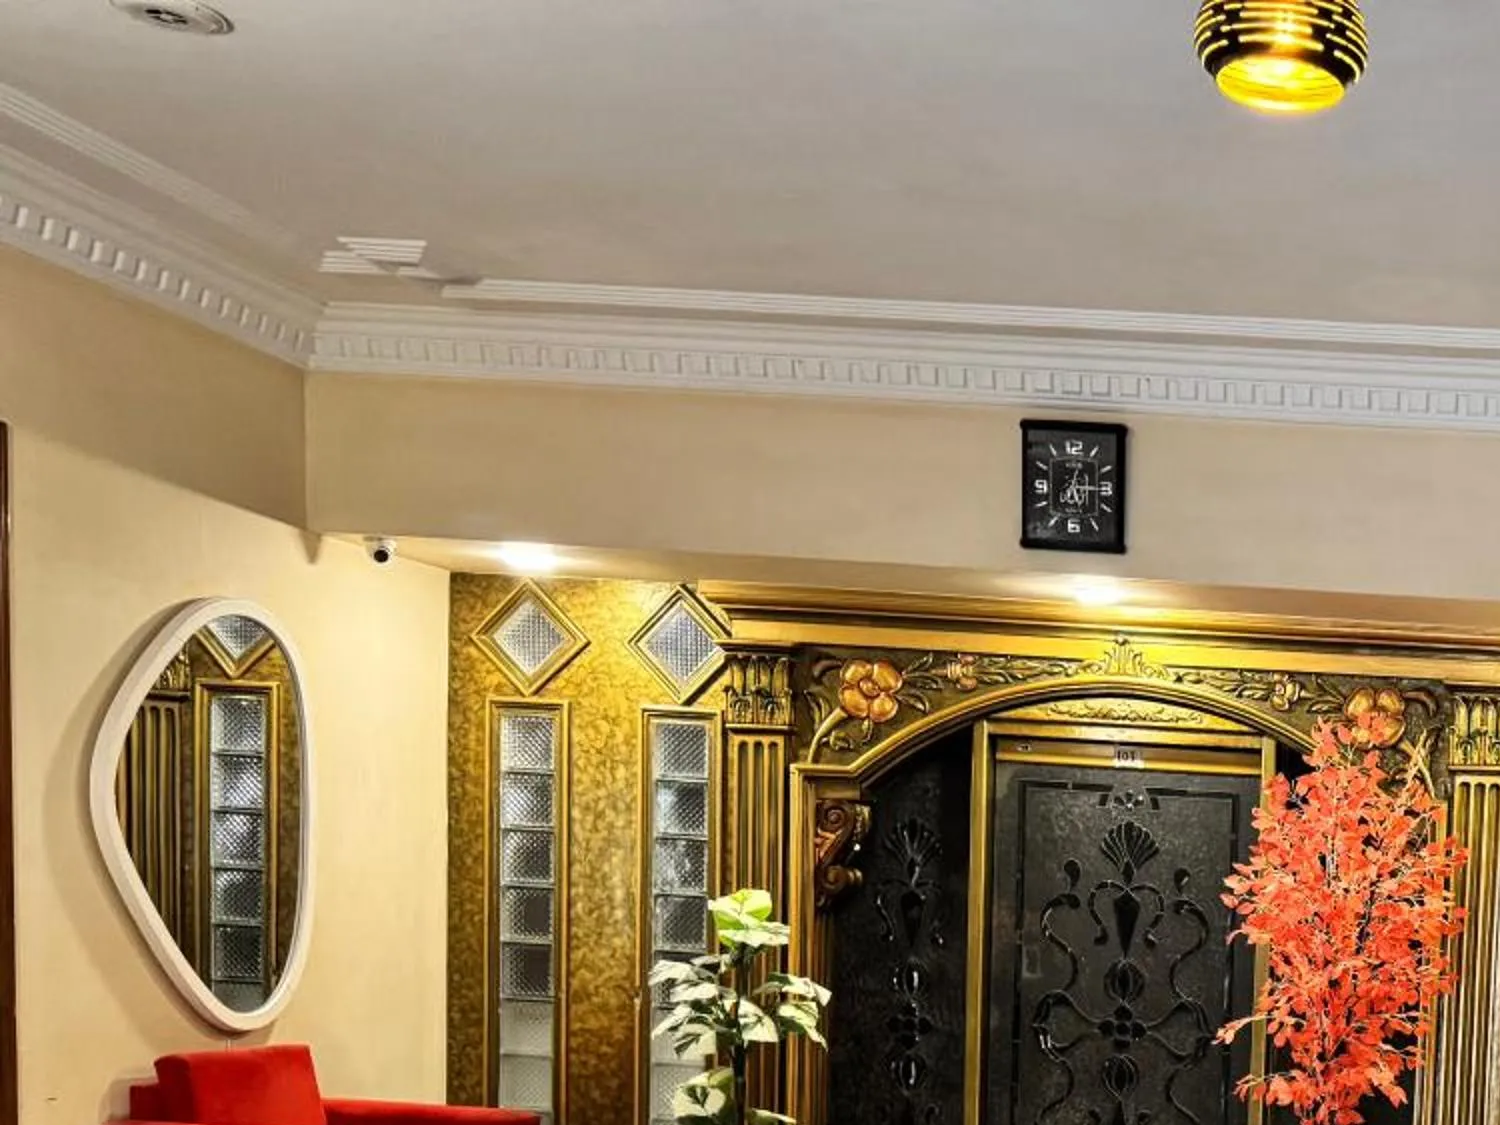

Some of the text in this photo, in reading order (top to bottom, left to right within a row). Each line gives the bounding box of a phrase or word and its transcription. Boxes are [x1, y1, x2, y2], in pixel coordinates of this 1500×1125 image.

[1065, 440, 1083, 455] 12
[1034, 480, 1048, 494] 9
[1100, 482, 1113, 496] 3
[1067, 519, 1080, 533] 6
